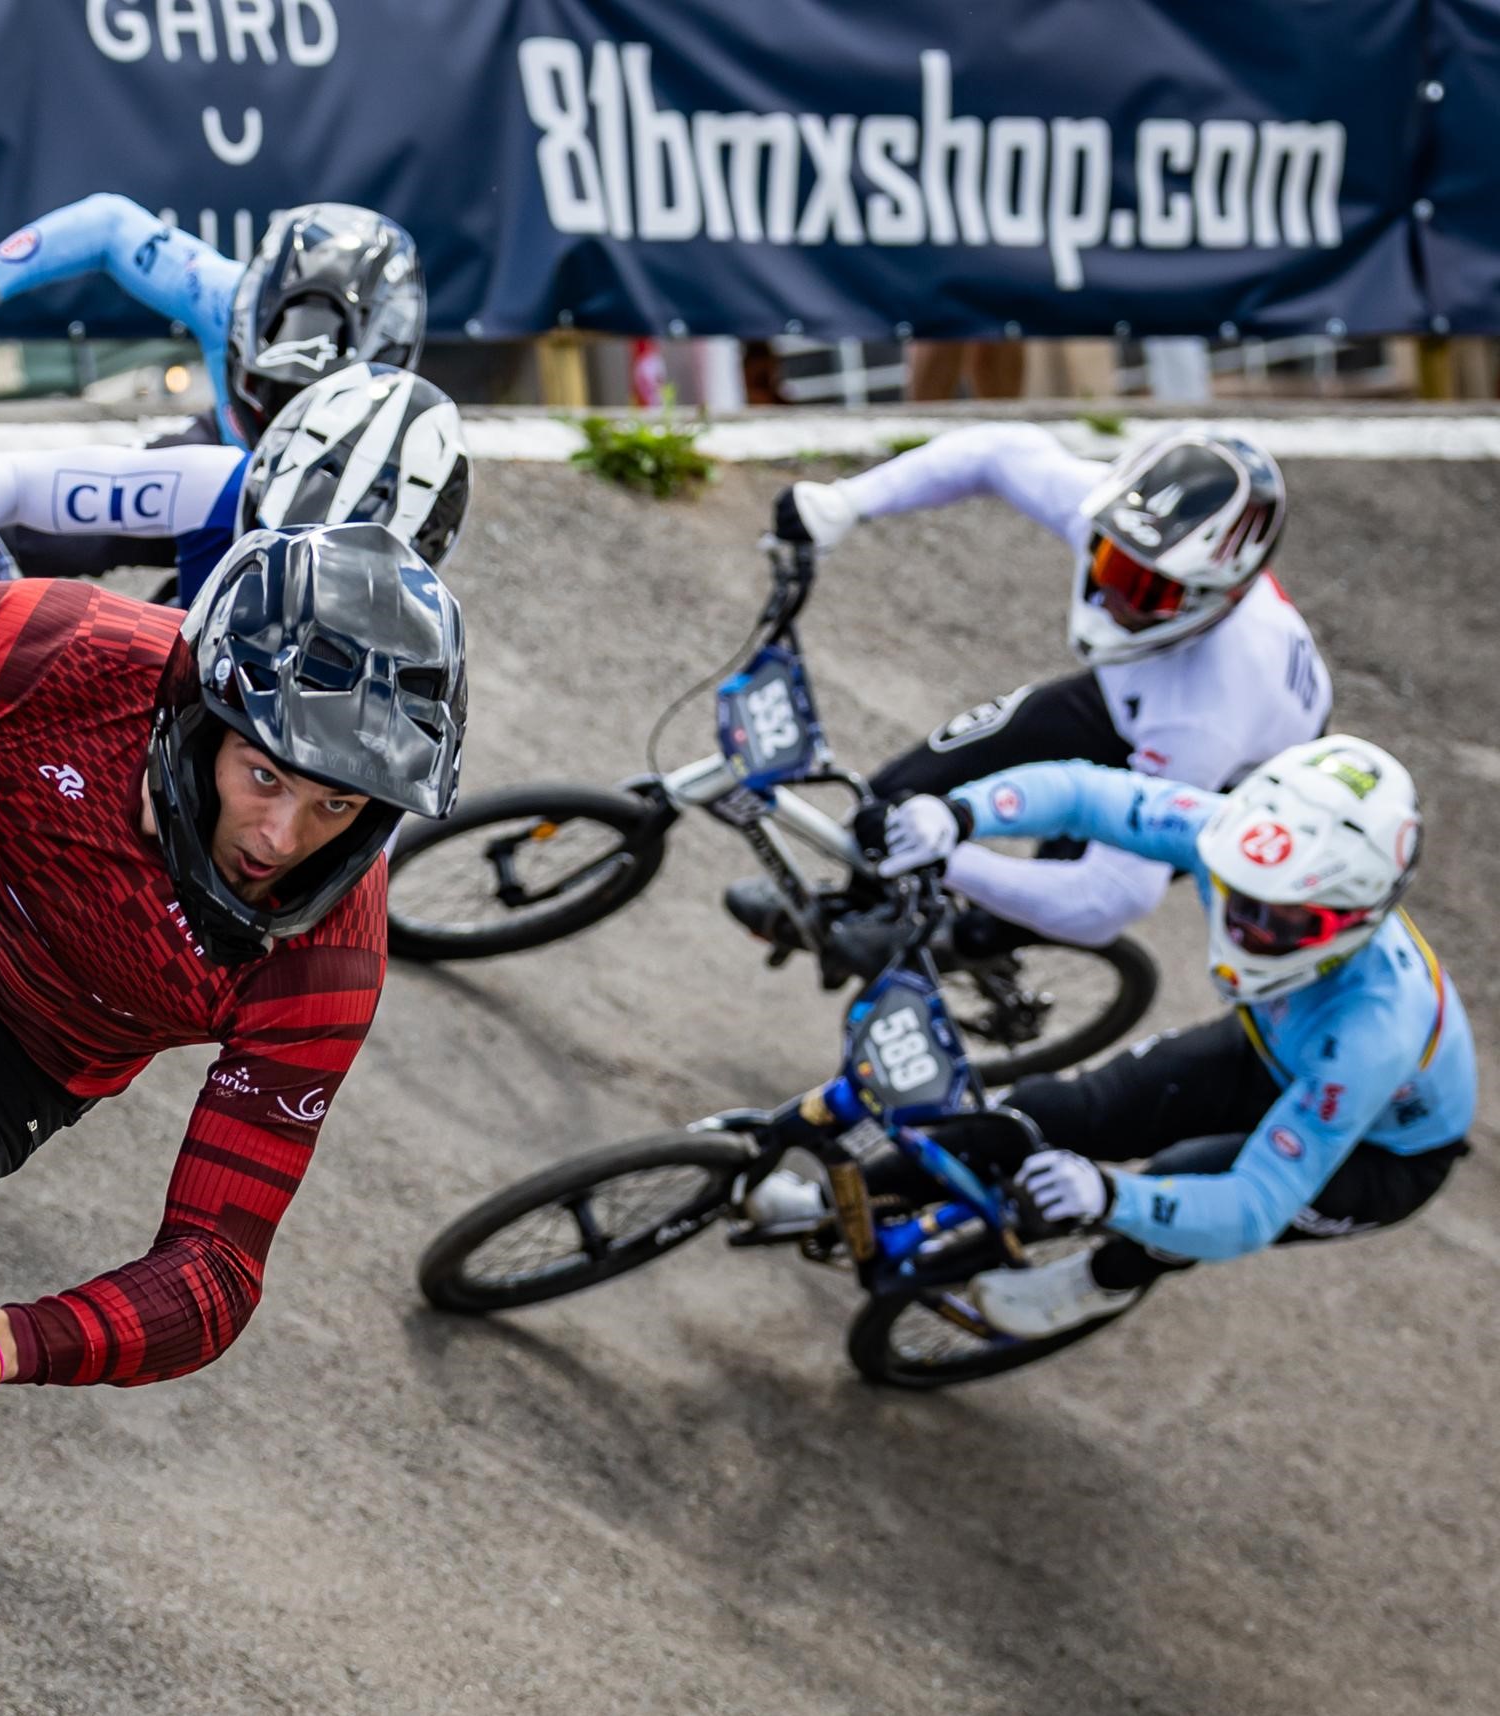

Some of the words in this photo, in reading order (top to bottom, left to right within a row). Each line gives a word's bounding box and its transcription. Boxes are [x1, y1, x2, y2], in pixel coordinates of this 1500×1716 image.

[518, 35, 1347, 292] 81bmxshop.com
[65, 482, 164, 524] CIC
[869, 1005, 940, 1094] 589
